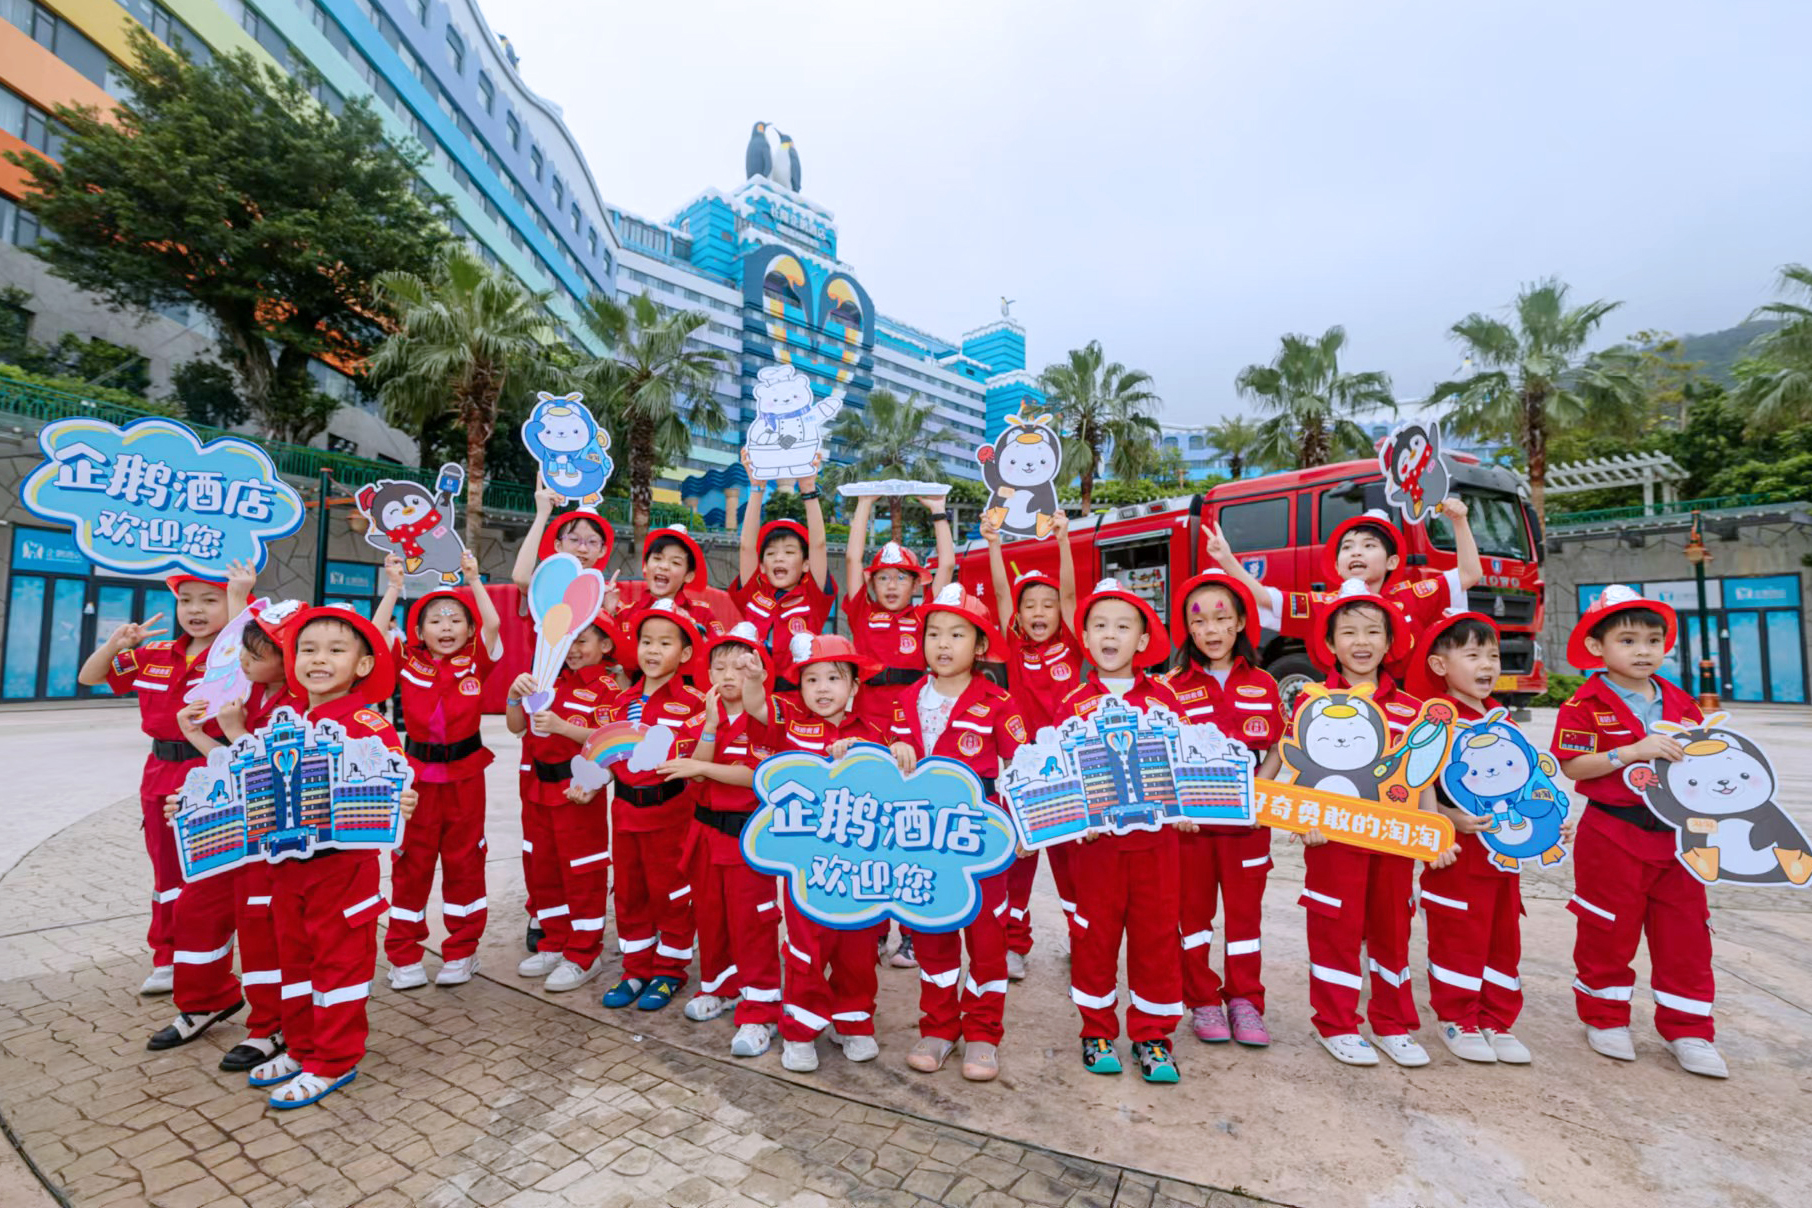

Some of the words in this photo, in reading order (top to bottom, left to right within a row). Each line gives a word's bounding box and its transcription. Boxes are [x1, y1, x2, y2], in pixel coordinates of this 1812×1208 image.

[53, 441, 275, 520] 企鹅酒店
[93, 509, 223, 559] 欢迎您
[768, 780, 987, 855] 企鹅酒店
[807, 854, 936, 905] 欢迎您
